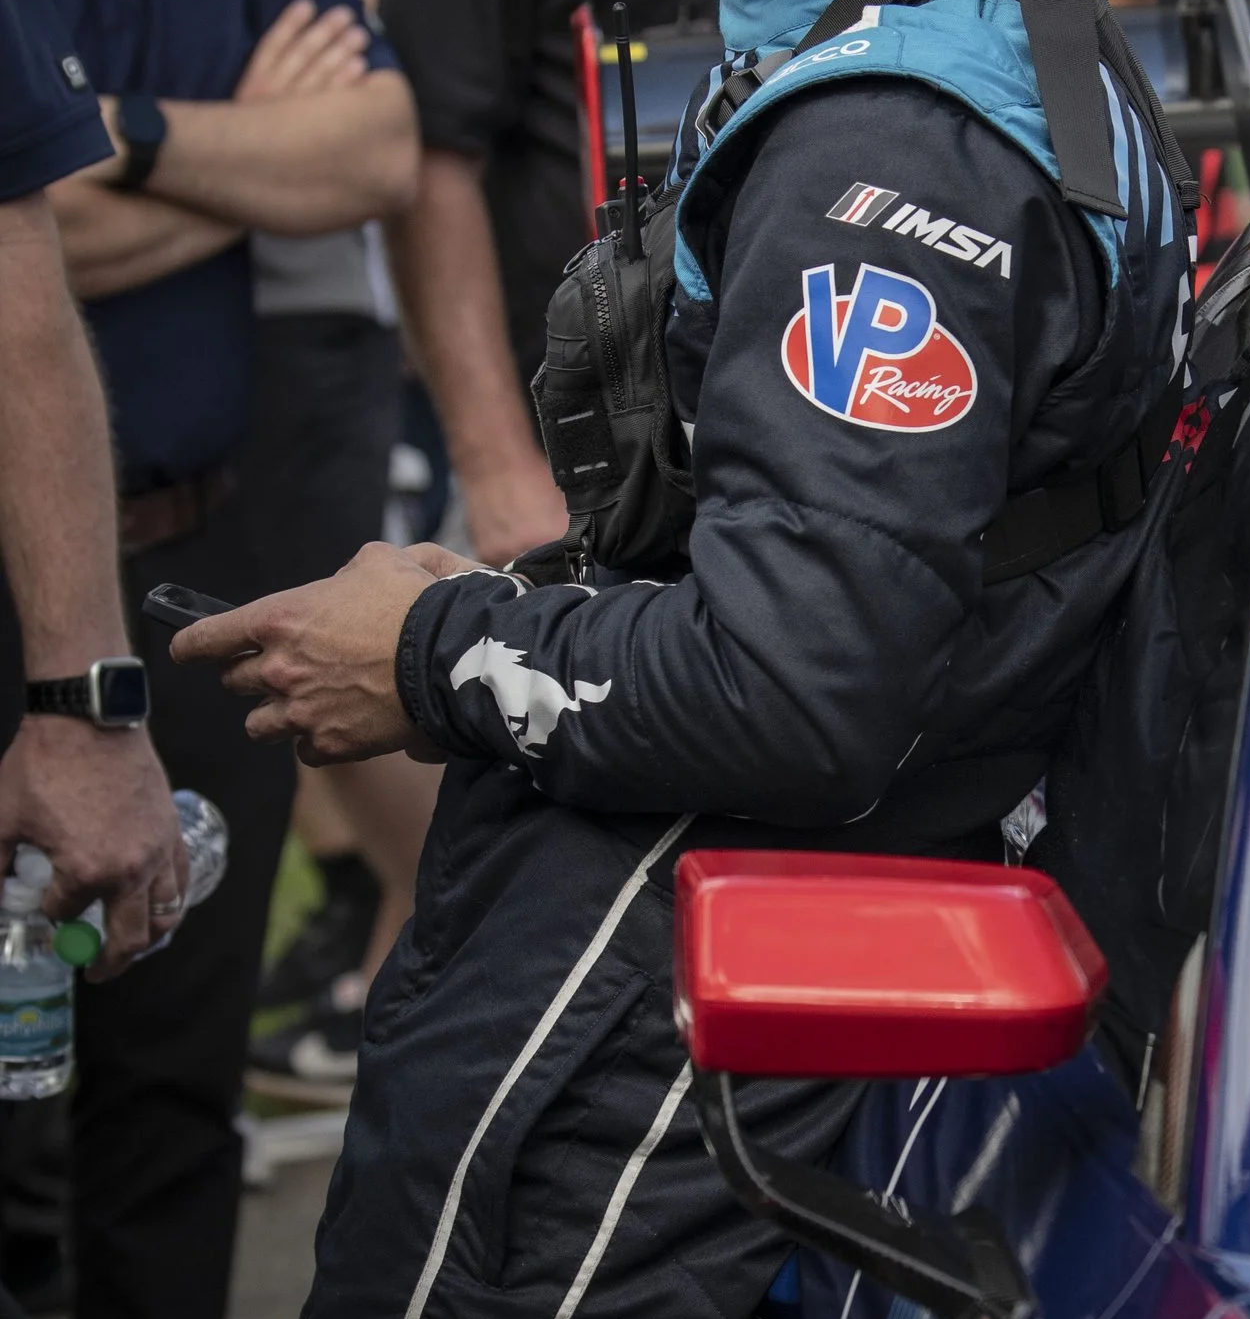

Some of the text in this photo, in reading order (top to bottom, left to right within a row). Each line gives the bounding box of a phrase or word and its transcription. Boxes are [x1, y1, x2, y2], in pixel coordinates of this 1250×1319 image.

[882, 202, 1013, 279] IMSA
[802, 262, 937, 418] VP
[859, 365, 973, 416] Racing
